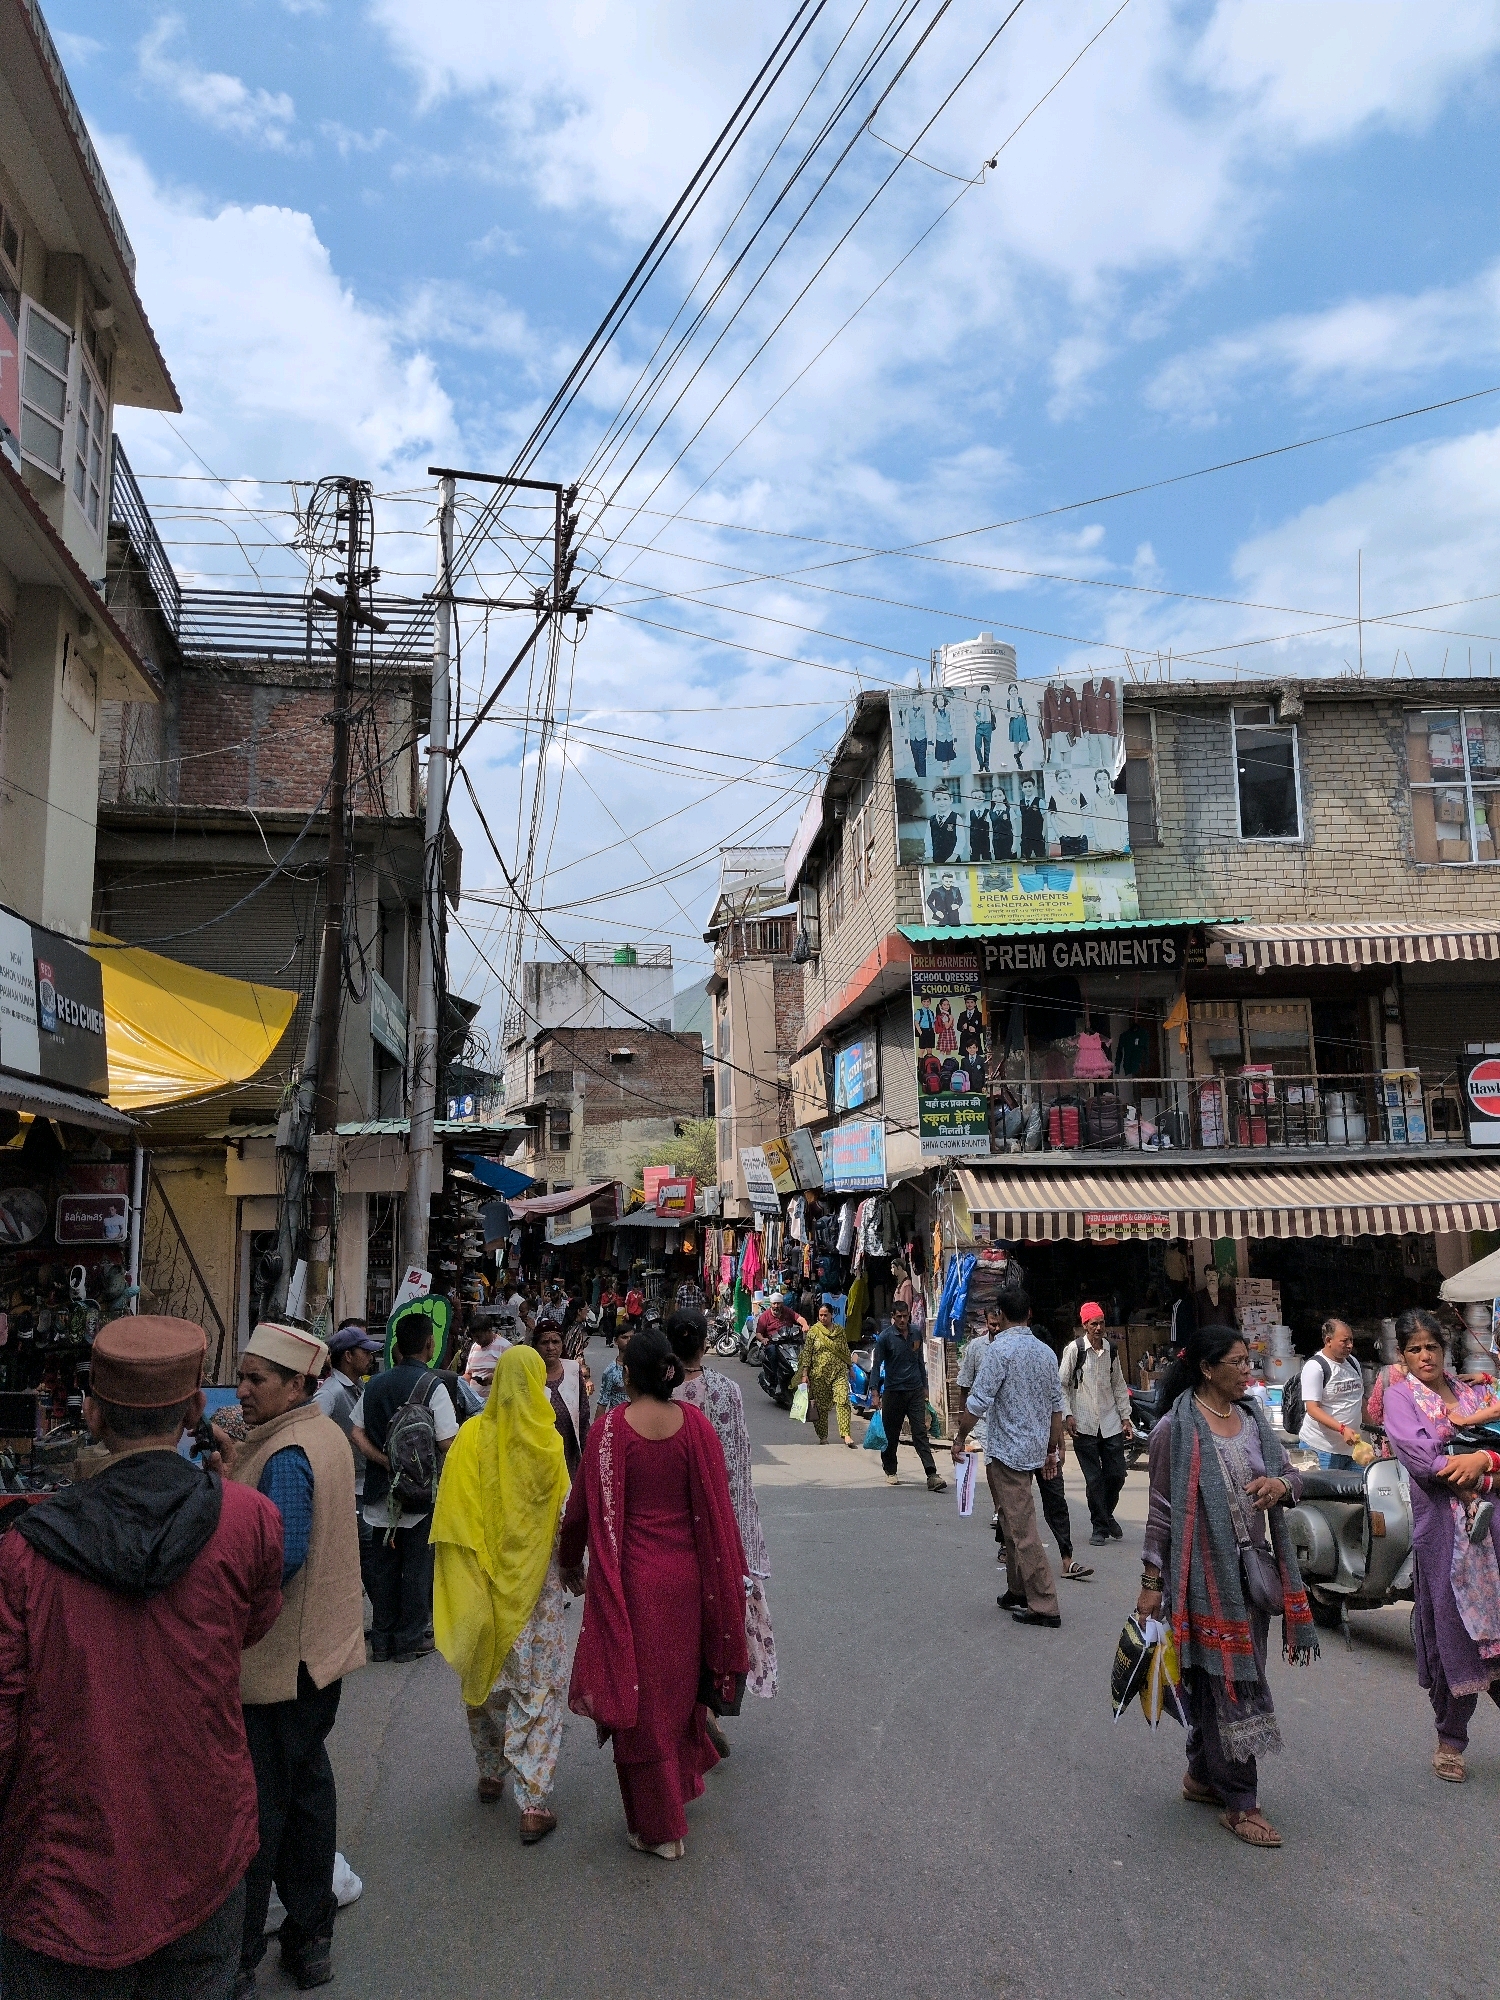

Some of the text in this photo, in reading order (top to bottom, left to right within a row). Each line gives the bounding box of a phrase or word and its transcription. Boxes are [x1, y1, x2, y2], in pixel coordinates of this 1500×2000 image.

[979, 893, 1069, 902] PREM GARMENTS
[985, 944, 1047, 970] PREM
[1052, 938, 1177, 968] GARMENTS
[913, 956, 978, 968] PREM GARMENTS
[913, 972, 979, 982] SCHOOL DRESSES
[920, 984, 971, 994] SCHOOL BAG
[940, 1099, 950, 1109] हर
[949, 1099, 970, 1108] प्रकार
[921, 1113, 950, 1126] स्कूल
[938, 1125, 963, 1135] मिलती
[64, 1211, 104, 1222] Bahamas
[1101, 1213, 1128, 1222] GARMENTS
